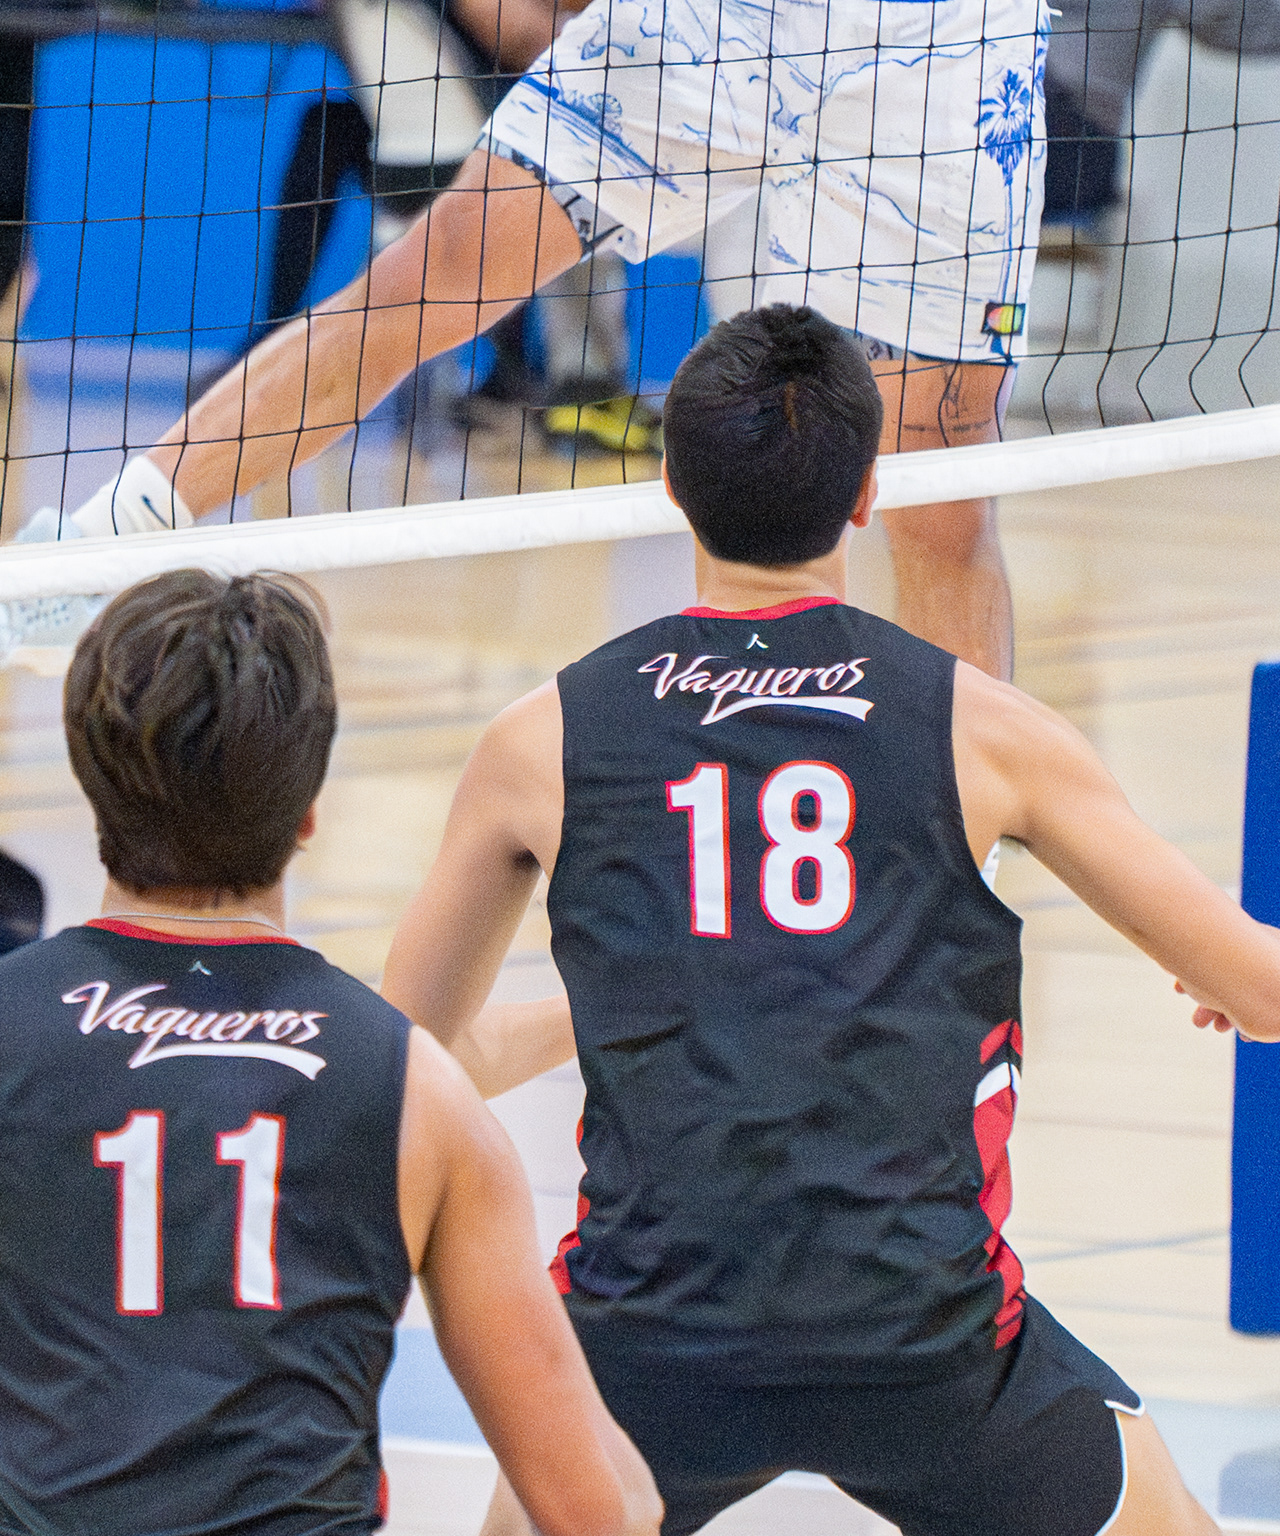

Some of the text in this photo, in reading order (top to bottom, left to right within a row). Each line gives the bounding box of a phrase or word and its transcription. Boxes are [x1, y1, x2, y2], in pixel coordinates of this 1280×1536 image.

[637, 652, 875, 725] Vaqueros
[665, 760, 857, 939] 18
[61, 980, 329, 1071] Vaqueros
[92, 1109, 287, 1317] 11
